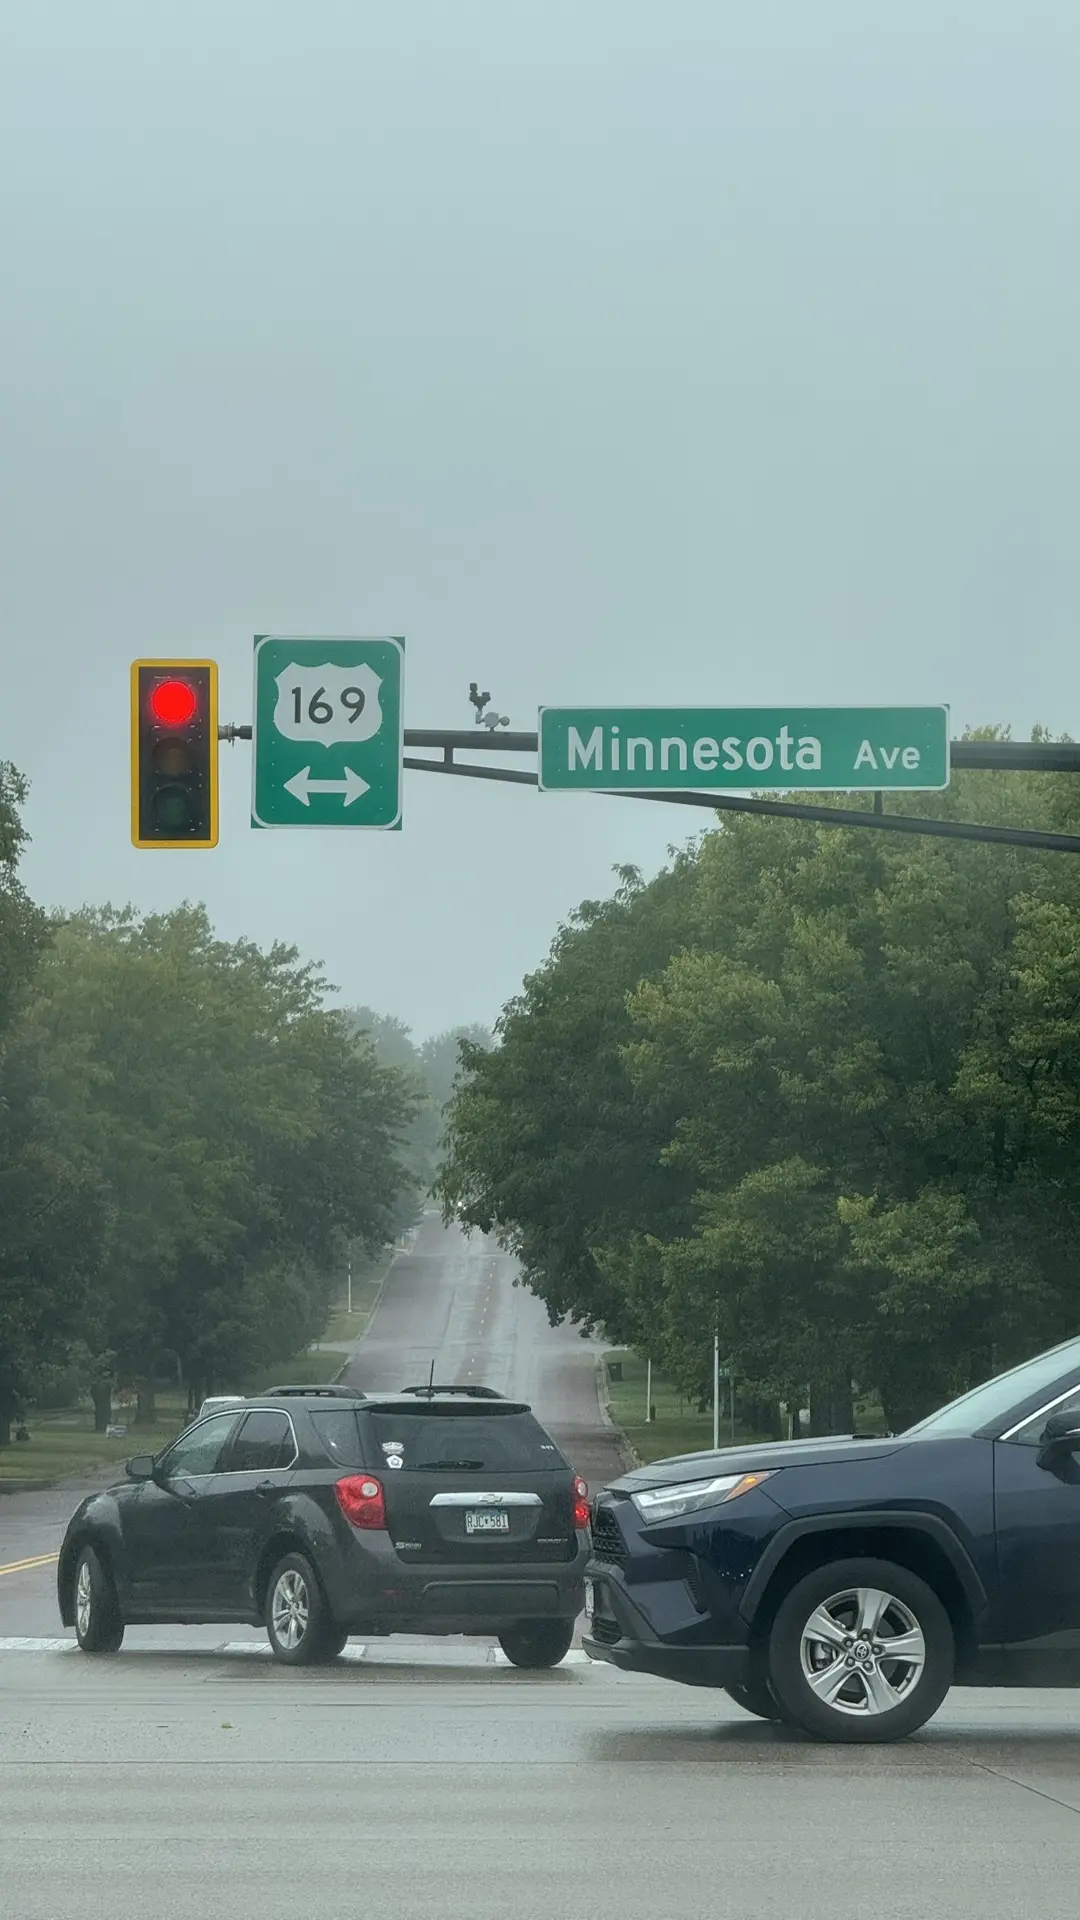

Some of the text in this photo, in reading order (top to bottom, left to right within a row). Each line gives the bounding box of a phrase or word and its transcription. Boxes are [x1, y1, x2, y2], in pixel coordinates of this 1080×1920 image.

[291, 686, 366, 725] 169
[567, 724, 920, 772] Minnesota Ave
